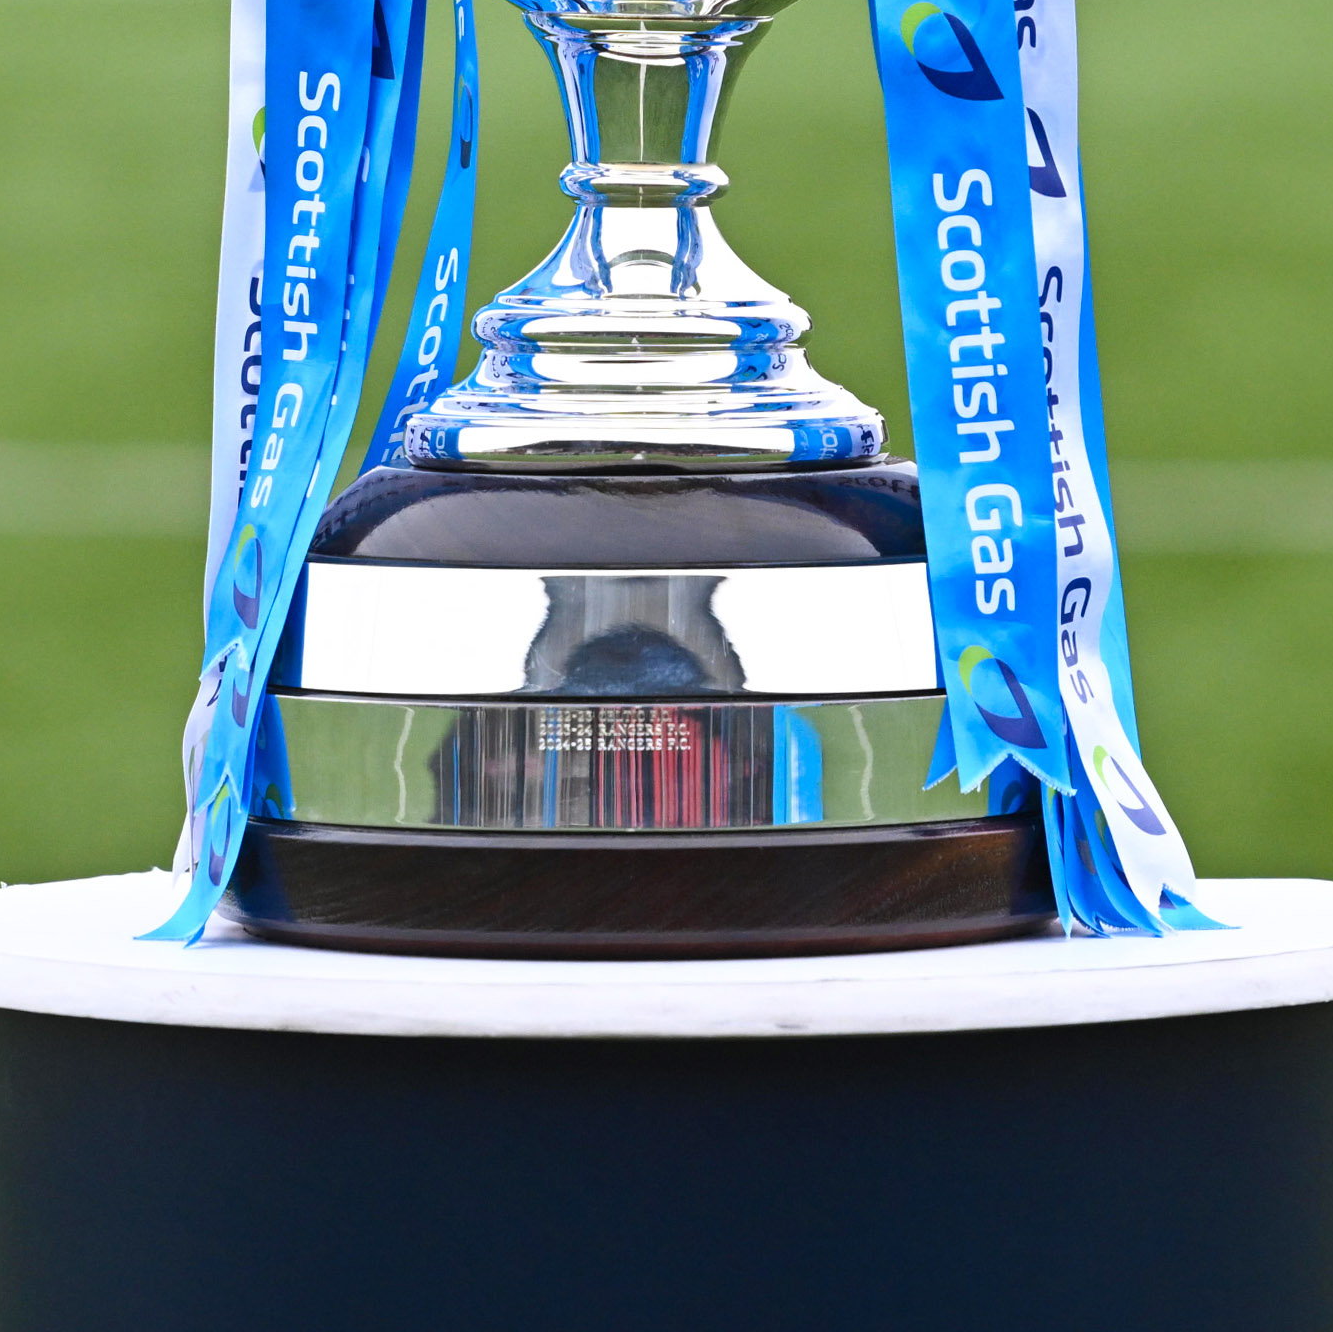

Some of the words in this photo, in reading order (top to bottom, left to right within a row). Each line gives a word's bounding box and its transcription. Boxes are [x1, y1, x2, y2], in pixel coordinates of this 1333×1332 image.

[282, 70, 342, 362] Scottish
[932, 167, 1015, 465] Scottish
[249, 382, 304, 509] Gas
[965, 483, 1023, 616] Gas
[1060, 575, 1095, 705] Gas
[538, 737, 593, 751] 2024-25
[597, 737, 663, 751] RANGERS
[667, 737, 692, 751] F.C.
[598, 723, 663, 737] RANGERS
[667, 723, 691, 737] F.C.
